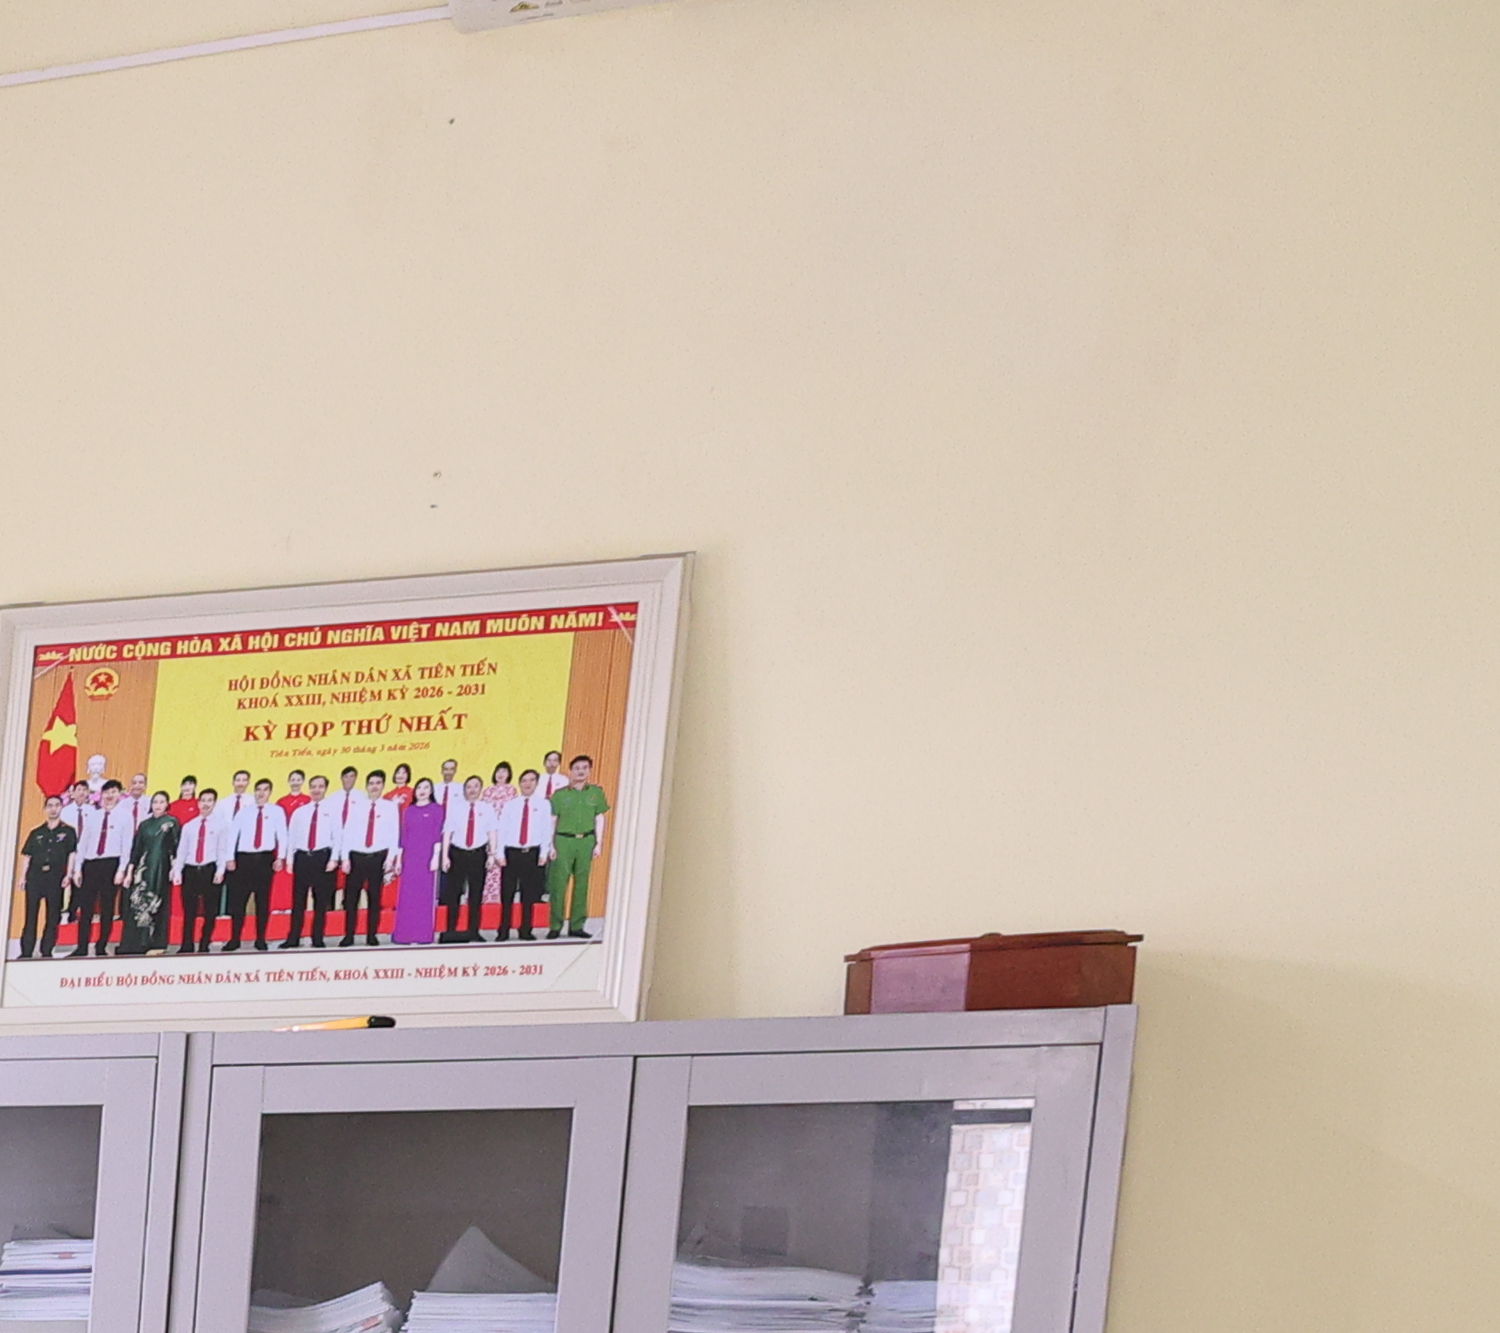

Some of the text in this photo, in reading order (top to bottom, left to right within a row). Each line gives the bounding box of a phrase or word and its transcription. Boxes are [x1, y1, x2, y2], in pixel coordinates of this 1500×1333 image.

[69, 645, 118, 663] NƯỚC
[122, 641, 172, 661] CỘNG
[219, 632, 243, 653] XÃ
[248, 630, 279, 652] HỘI
[284, 627, 322, 648] CHỦ
[327, 625, 385, 645] NGHĨA
[390, 620, 431, 642] VIỆT
[435, 617, 481, 638] NAM
[550, 609, 604, 631] NĂM!
[228, 674, 256, 693] HỘI
[306, 666, 352, 687] NHÂN
[354, 665, 389, 685] DÂN
[391, 664, 413, 682] XÃ
[418, 661, 455, 679] TIÊN
[460, 657, 498, 677] TIẾN
[237, 693, 279, 711] KHOÁ
[330, 686, 382, 705] NHIỆM
[413, 685, 445, 700] 2026
[457, 683, 487, 697] 2031
[243, 706, 469, 742] KỲ HỌP THỨ NHẤT
[265, 970, 295, 982] TIÊN
[483, 965, 509, 977] 2026
[519, 964, 544, 976] 2031
